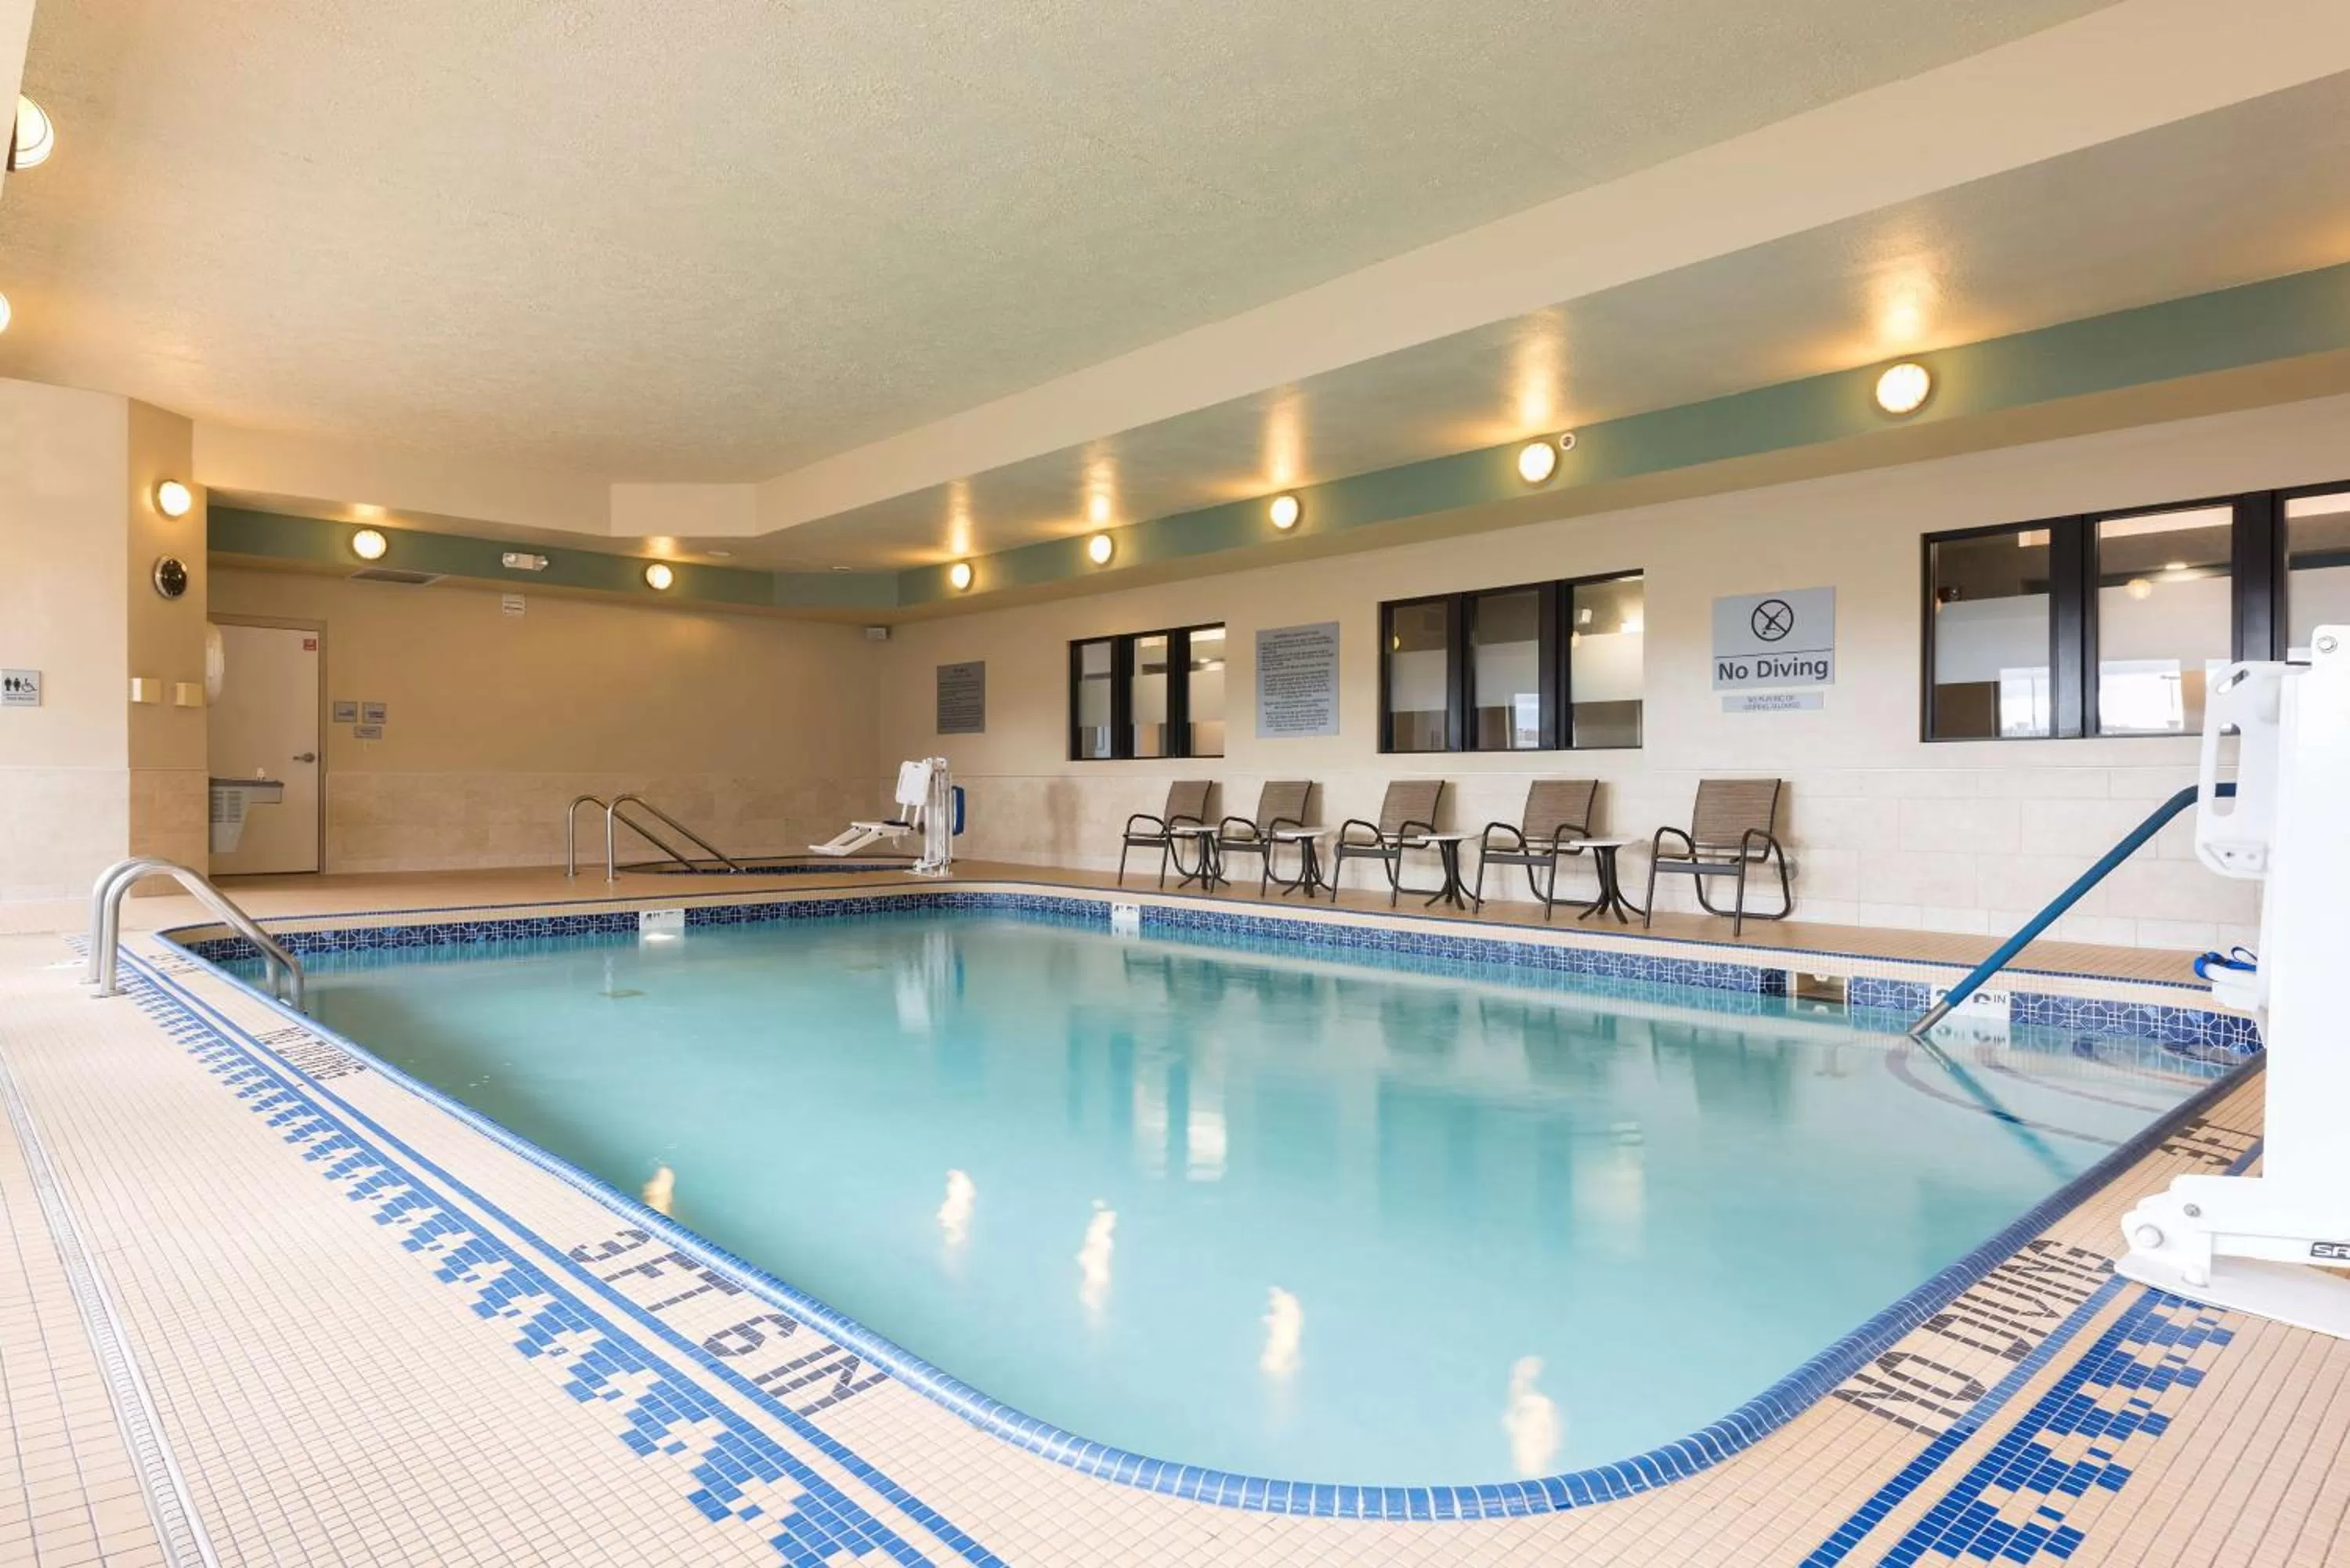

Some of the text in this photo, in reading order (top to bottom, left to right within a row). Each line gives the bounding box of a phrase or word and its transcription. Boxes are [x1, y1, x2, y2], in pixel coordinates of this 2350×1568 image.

[1719, 656, 1828, 681] No Diving
[1835, 1239, 2116, 1436] NO DIVING
